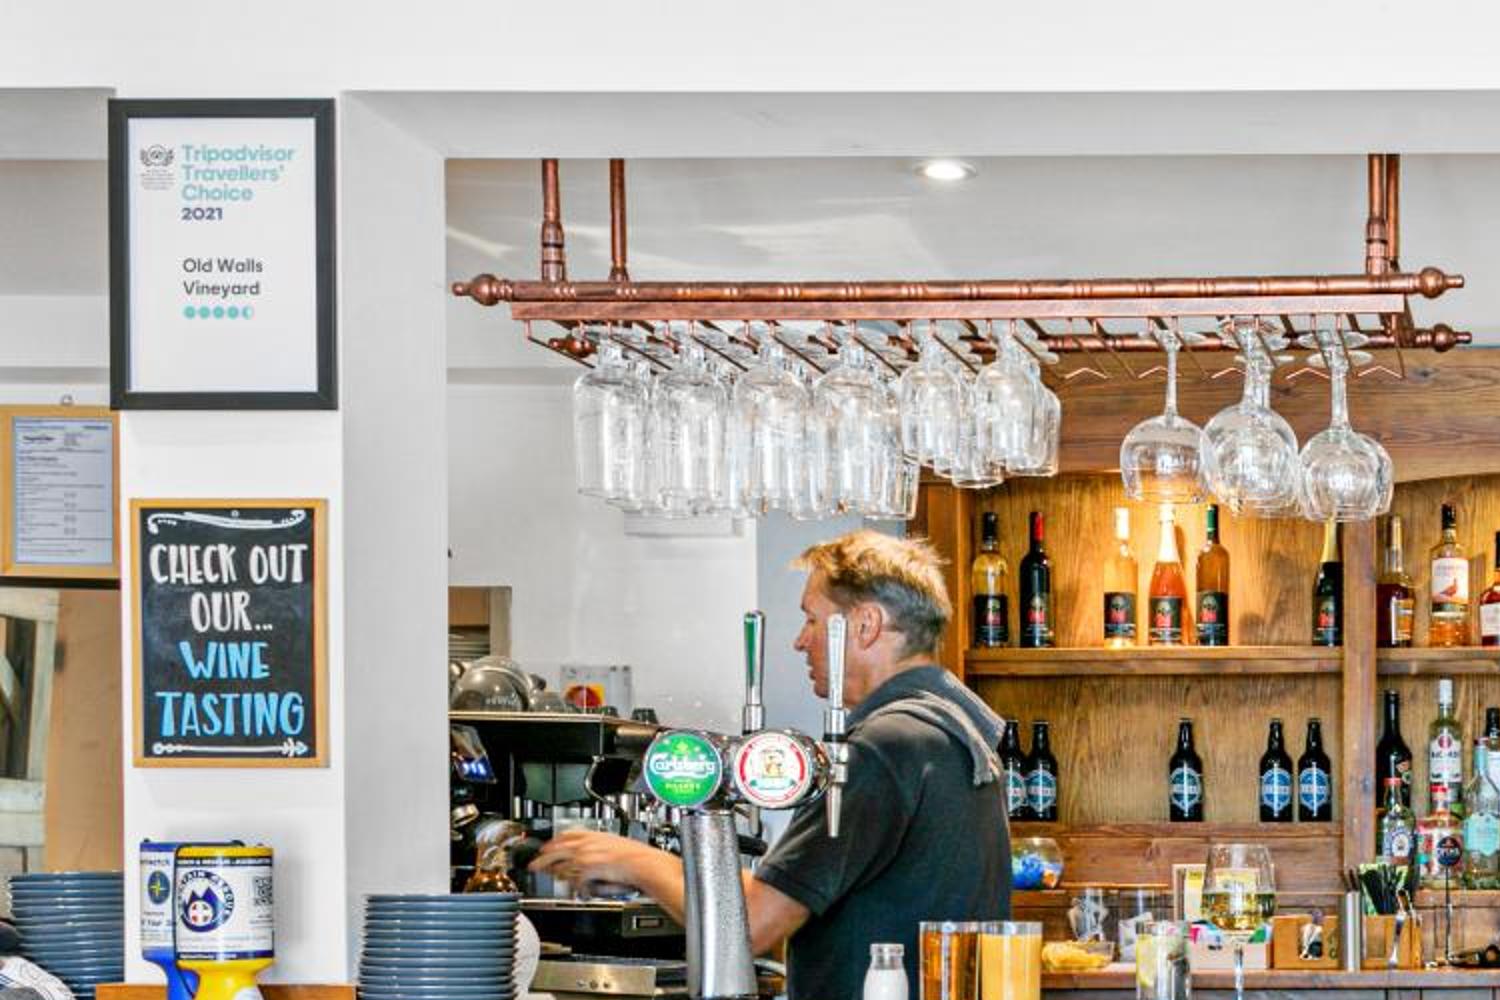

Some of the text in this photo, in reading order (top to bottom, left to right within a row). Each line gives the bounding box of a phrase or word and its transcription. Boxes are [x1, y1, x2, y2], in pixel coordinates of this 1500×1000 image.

[182, 144, 295, 163] Tripadvisor
[182, 165, 285, 181] Travellers'
[181, 184, 253, 201] Choice
[181, 207, 223, 221] 2021
[182, 258, 263, 273] Old Walls
[183, 281, 260, 298] Vineyard
[150, 544, 308, 584] CHECK OUT
[179, 641, 270, 680] WINE
[155, 692, 304, 736] TASTING
